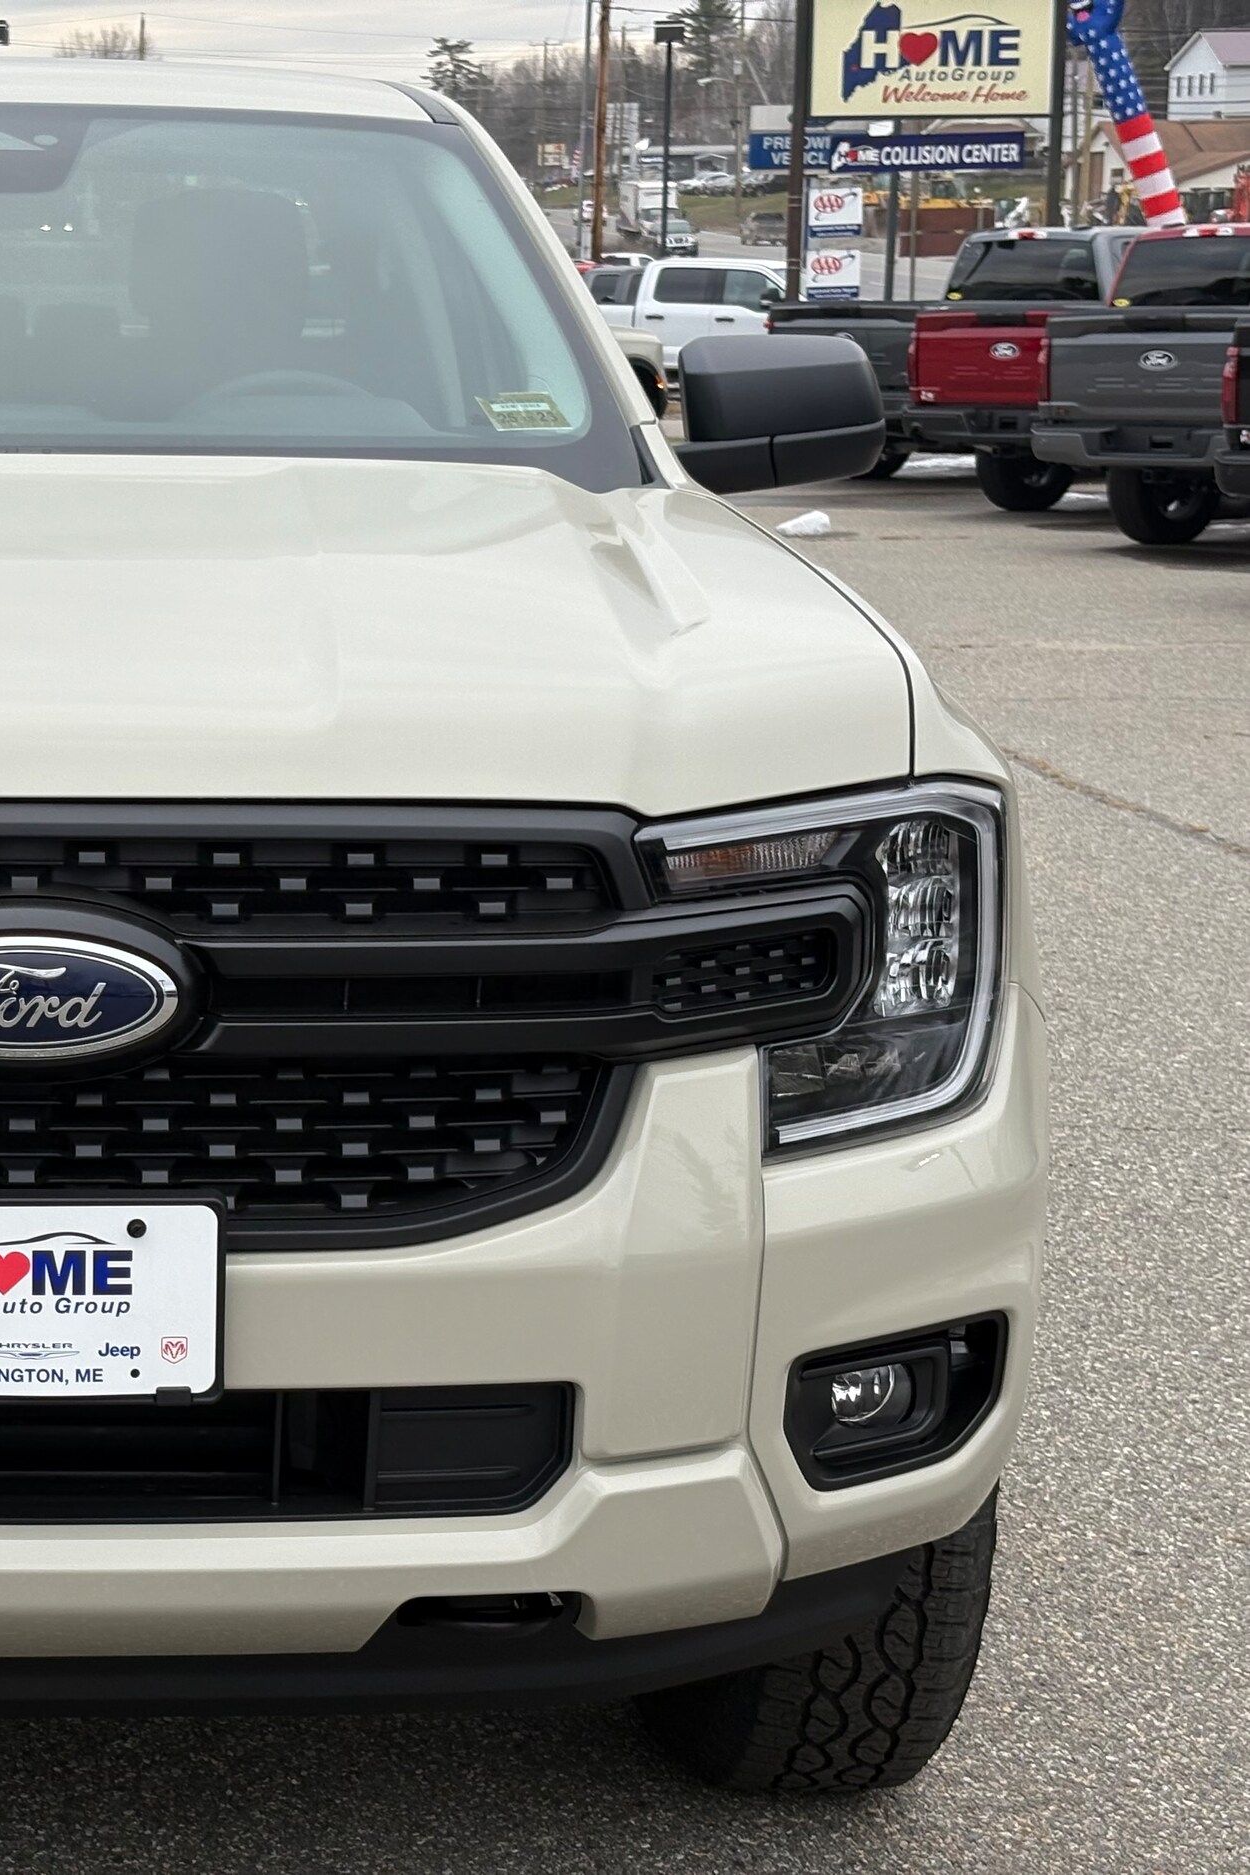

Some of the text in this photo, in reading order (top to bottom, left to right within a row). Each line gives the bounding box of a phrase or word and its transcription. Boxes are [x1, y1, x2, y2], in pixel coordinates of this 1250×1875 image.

[881, 83, 1028, 104] Welcome Home
[880, 144, 960, 166] COLLISION
[961, 142, 1021, 165] CENTER
[54, 1298, 132, 1318] Group
[98, 1342, 141, 1360] Jeep
[75, 1368, 104, 1383] ME
